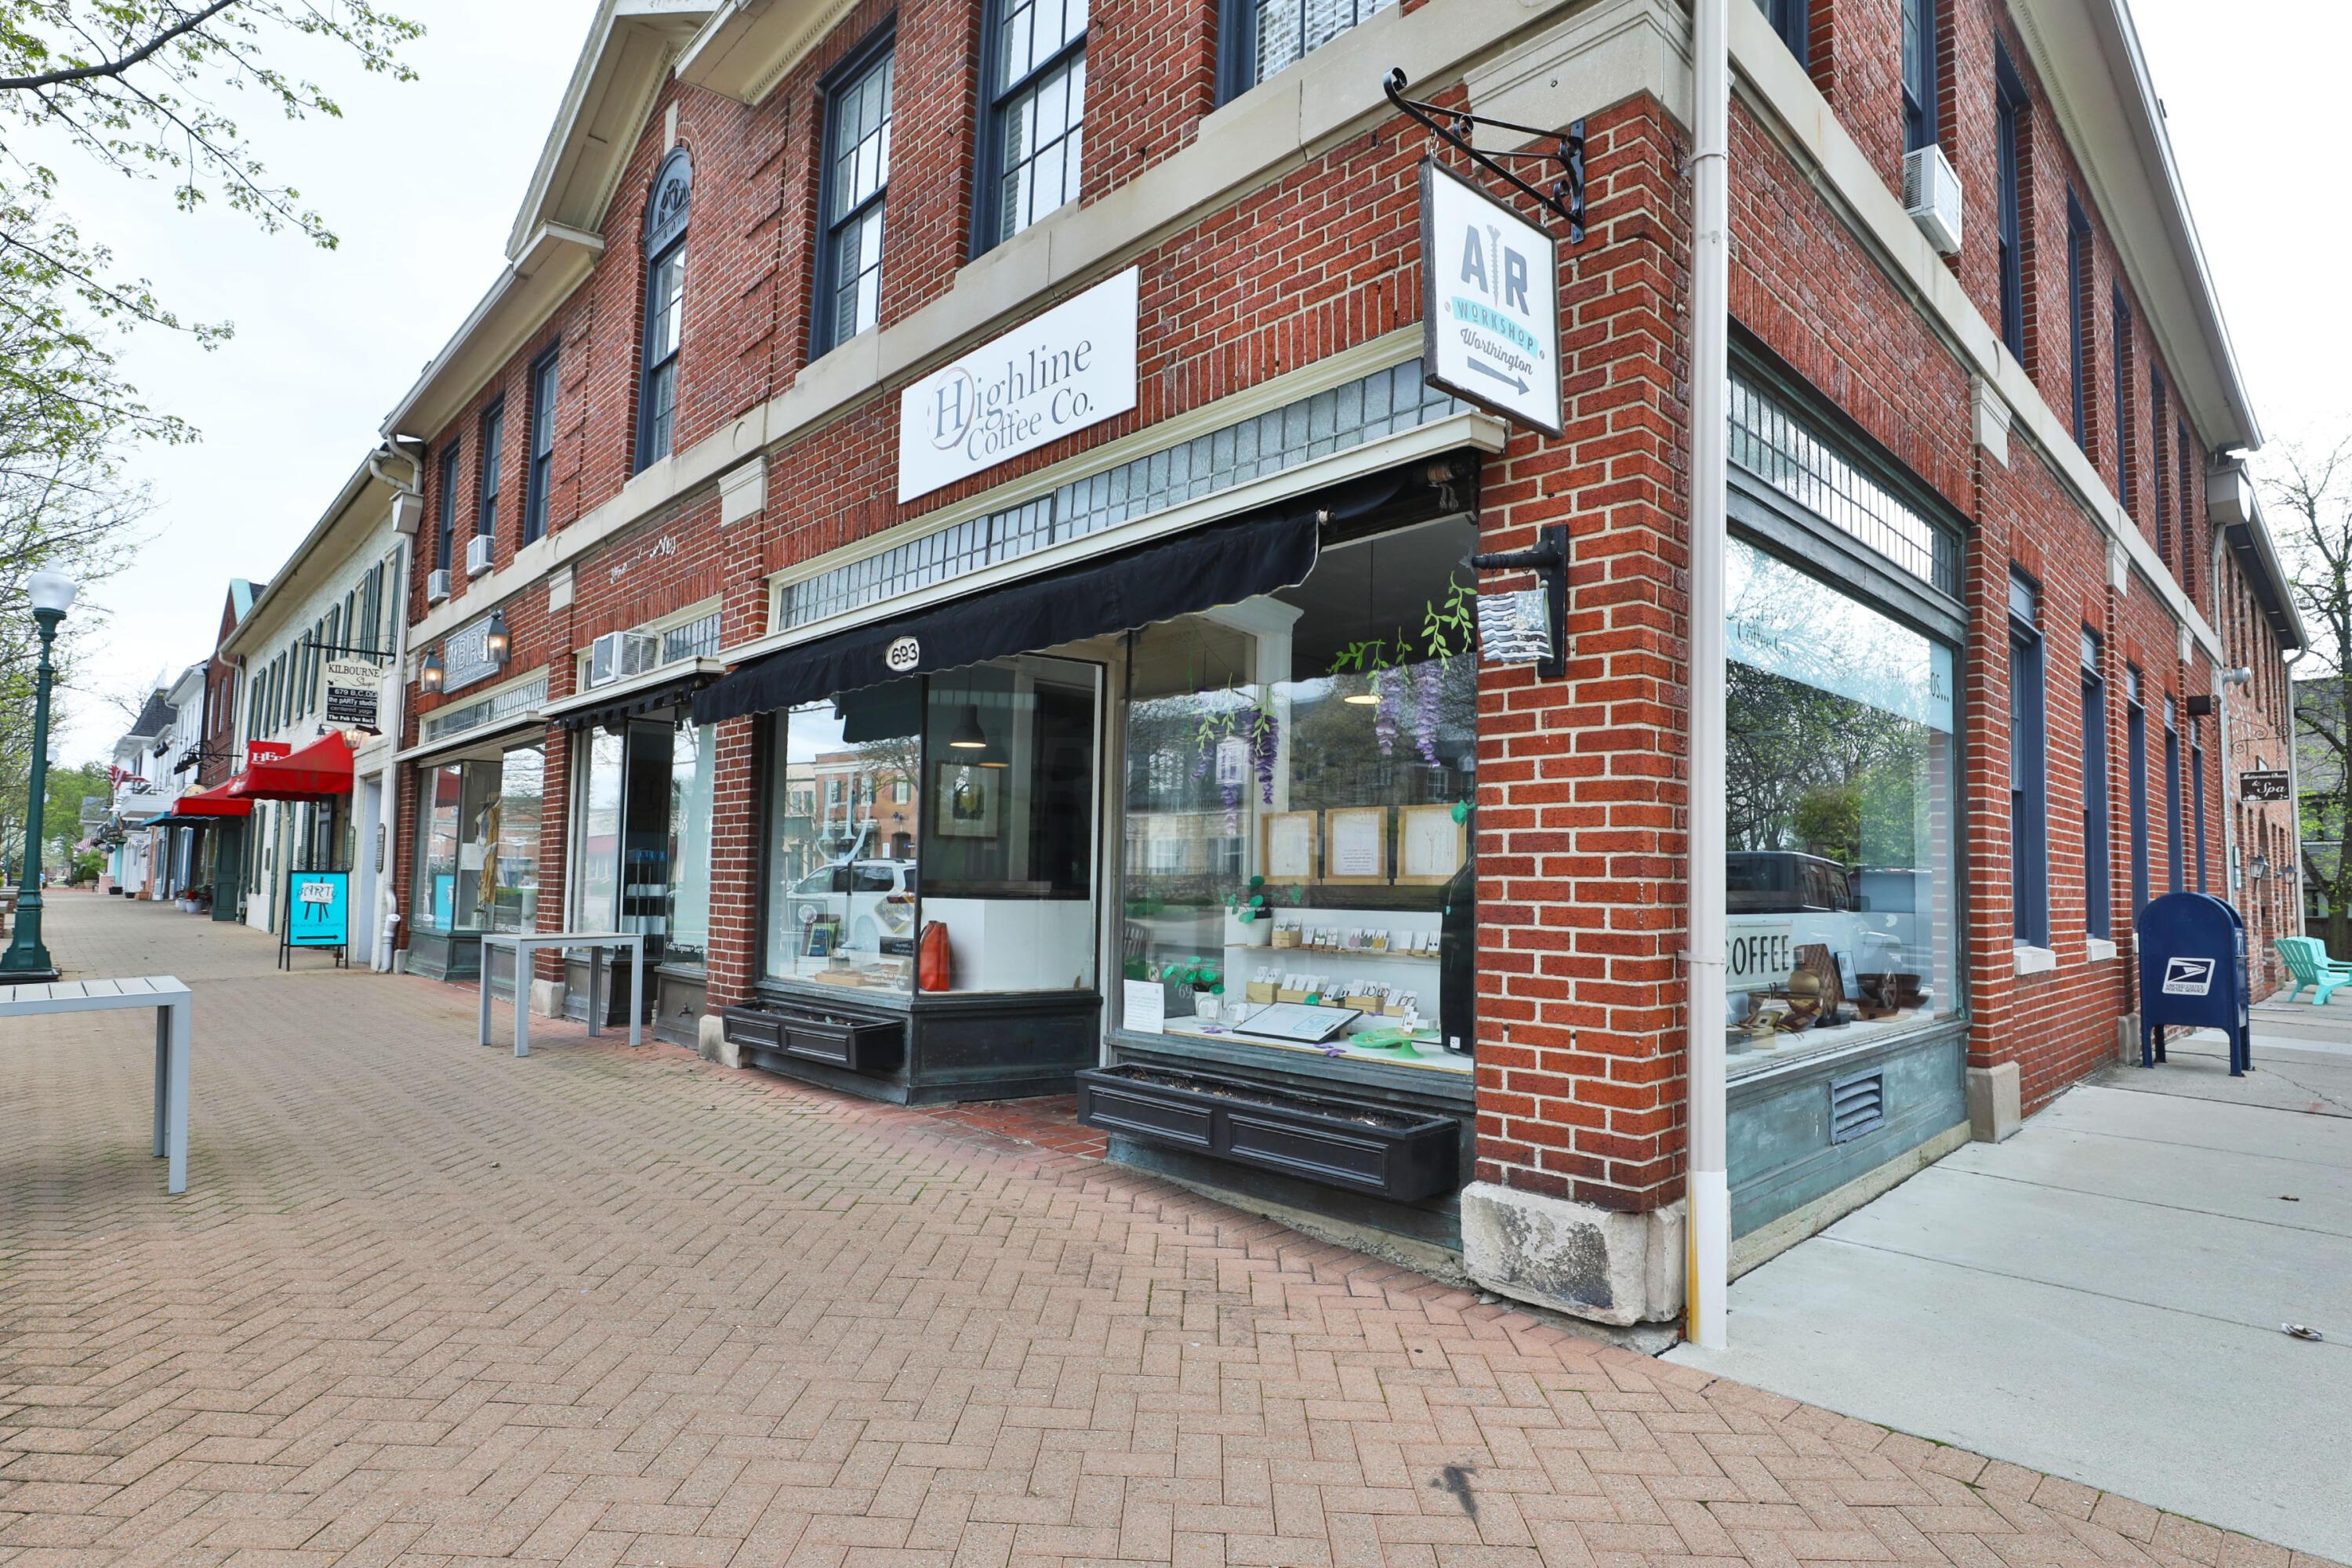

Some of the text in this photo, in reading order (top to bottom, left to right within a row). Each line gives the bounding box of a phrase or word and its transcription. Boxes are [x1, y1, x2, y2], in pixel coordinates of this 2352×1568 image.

[1457, 300, 1534, 351] WORKSHOP
[1461, 328, 1534, 376] Worthington
[933, 340, 1092, 441] Highline
[967, 386, 1094, 461] Coffee Co.
[328, 664, 380, 677] KILBOURNE
[892, 643, 917, 665] 693
[2256, 782, 2287, 797] Spa
[1726, 935, 1789, 975] OFFEE
